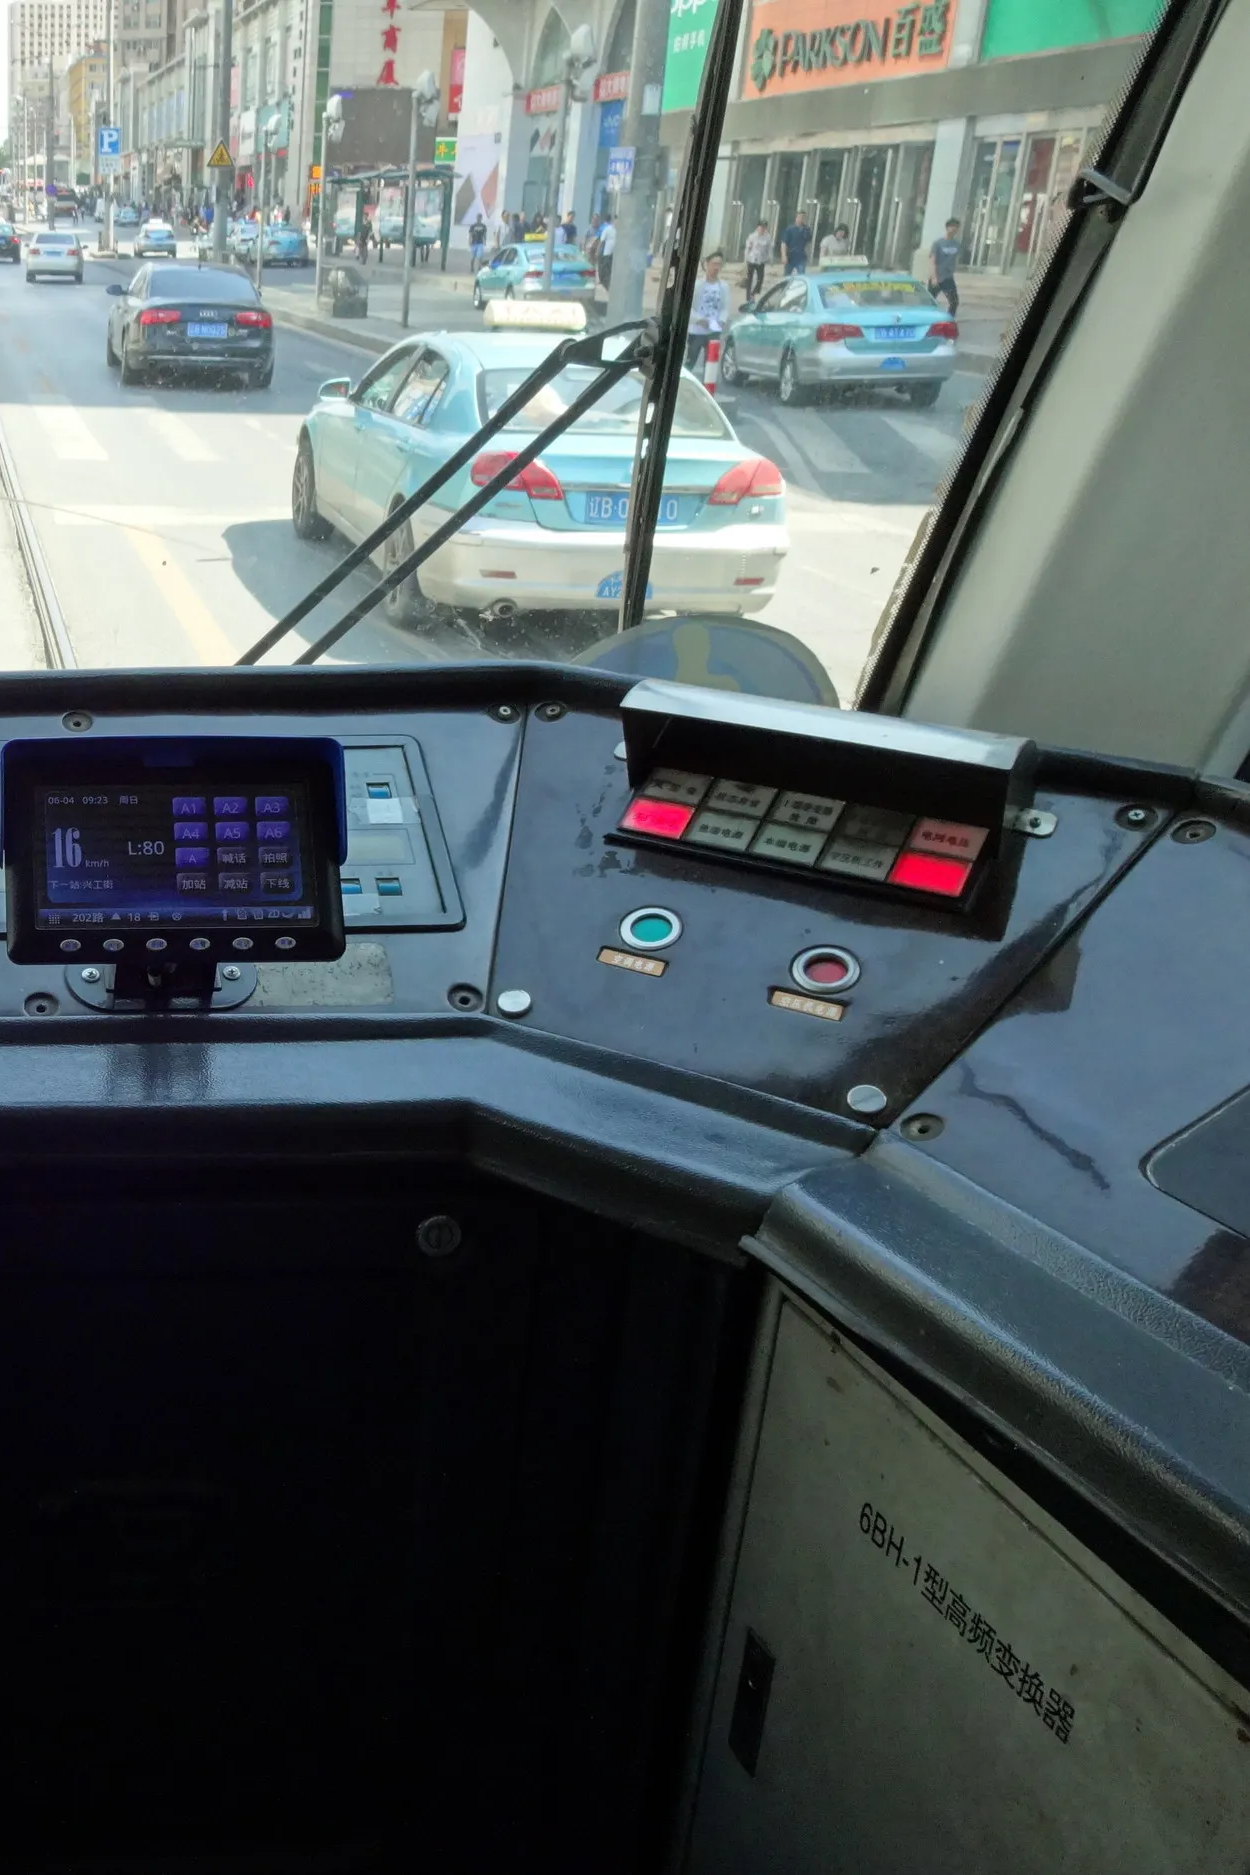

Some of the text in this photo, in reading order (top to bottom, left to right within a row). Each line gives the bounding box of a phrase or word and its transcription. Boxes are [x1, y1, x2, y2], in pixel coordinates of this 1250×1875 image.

[776, 0, 951, 78] PARKSON 百盛
[100, 129, 119, 153] P
[48, 795, 138, 805] 06-04 09:23 周日
[181, 803, 196, 814] A1
[222, 803, 239, 814] A2
[263, 803, 281, 814] A3
[182, 828, 200, 839] A4
[223, 828, 241, 839] A5
[265, 827, 283, 838] A6
[52, 827, 110, 868] 16 km/h
[128, 840, 165, 855] L:80
[188, 854, 197, 863] A
[222, 853, 246, 864] 喊话
[263, 852, 288, 864] 拍照
[48, 880, 114, 890] 下一站:兴工街
[182, 879, 206, 890] 加站
[223, 878, 248, 890] 减站
[266, 878, 290, 889] 下线
[72, 912, 141, 923] 202路 18
[859, 1502, 1076, 1745] 6BH-1型高频变换器
